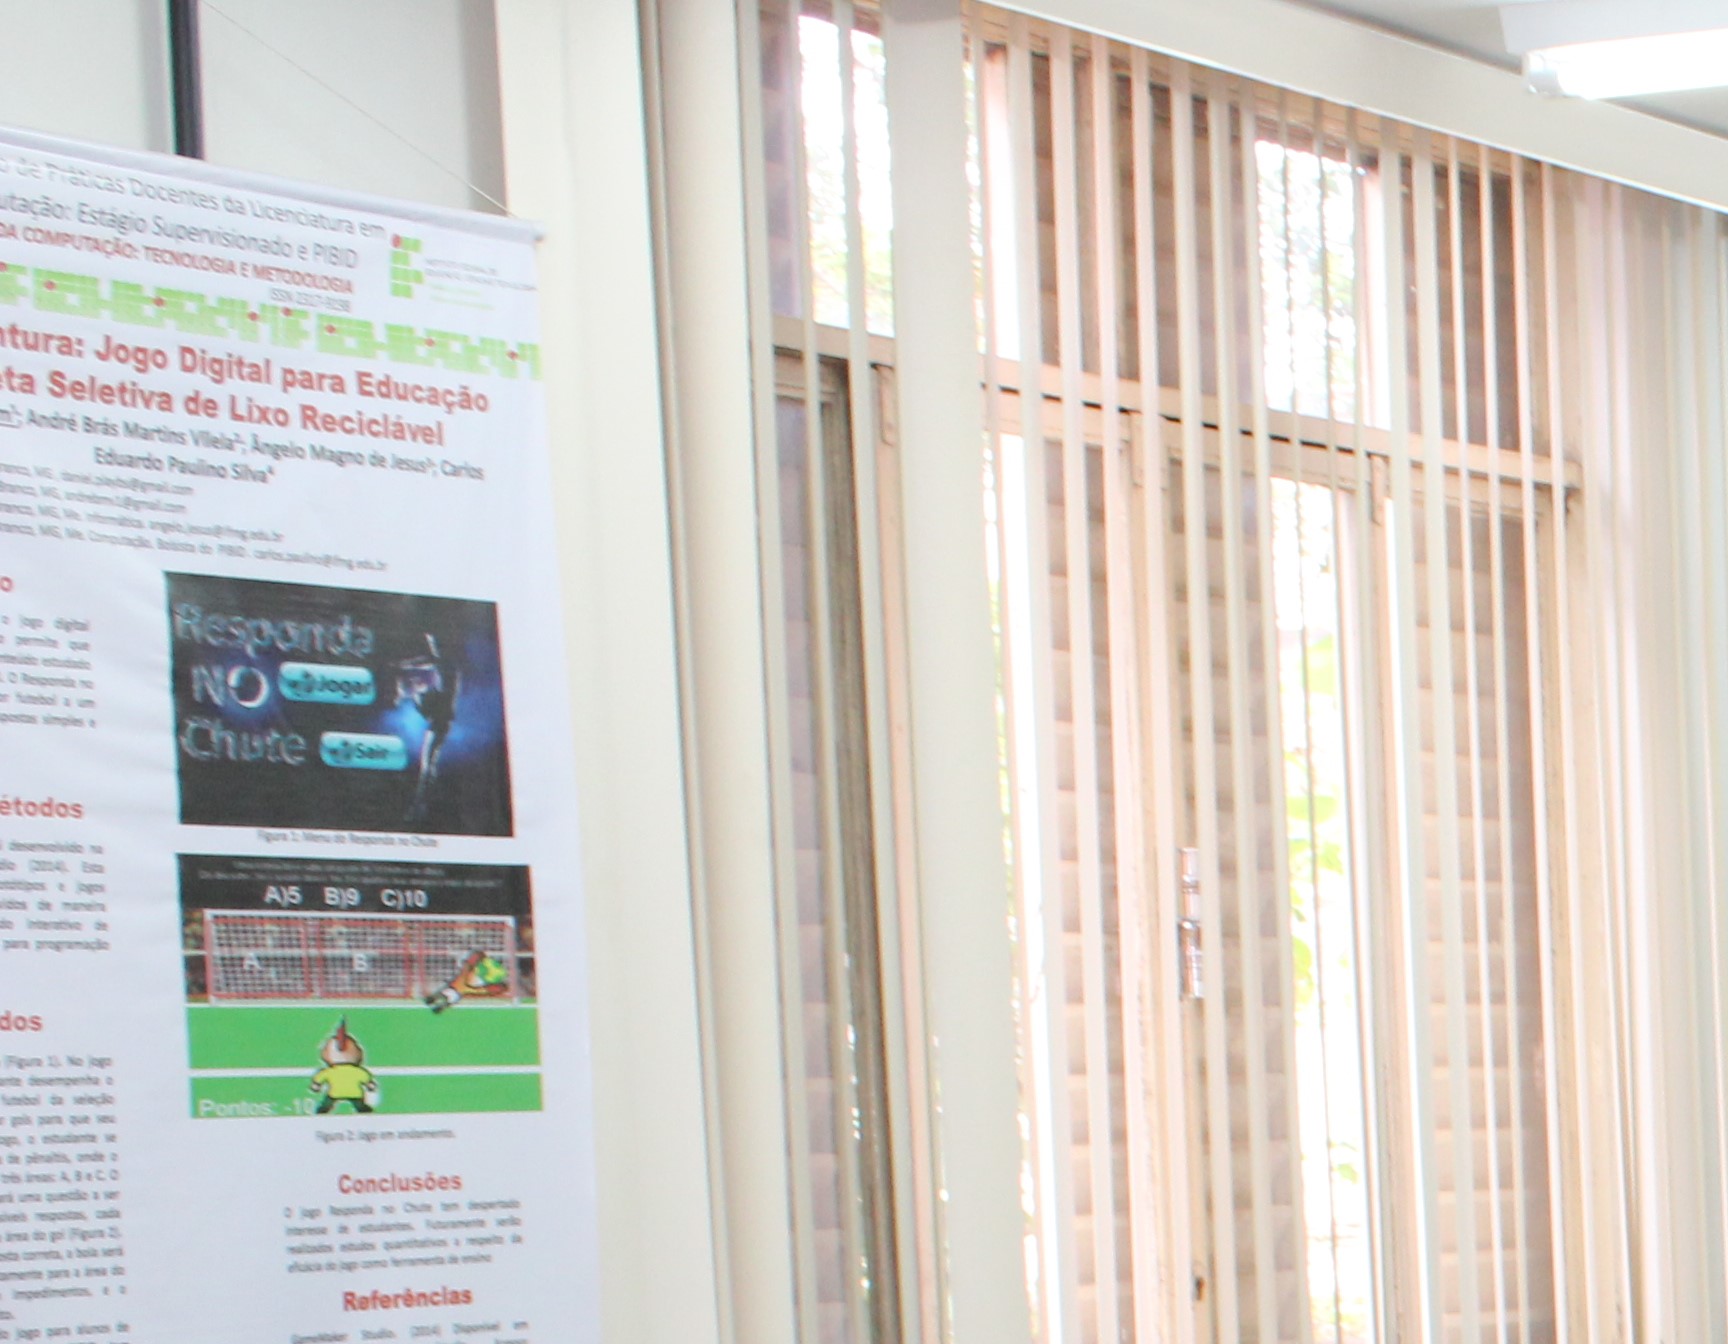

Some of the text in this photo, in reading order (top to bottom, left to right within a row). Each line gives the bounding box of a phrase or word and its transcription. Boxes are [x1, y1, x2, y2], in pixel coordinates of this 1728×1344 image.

[129, 178, 219, 210] Docentes
[223, 196, 247, 215] da
[251, 201, 353, 234] Licenciatura
[360, 222, 386, 239] em
[23, 225, 138, 259] COMPUTAÇÃO:
[143, 245, 237, 275] TECNOLOGIA
[240, 261, 250, 278] E
[254, 264, 354, 294] METODOLOGIA
[77, 202, 147, 235] Estágio
[152, 215, 292, 259] Supervisionado
[297, 244, 308, 258] e
[313, 242, 359, 269] PIBID
[95, 334, 169, 374] Jogo
[179, 345, 272, 385] Digital
[282, 366, 346, 394] para
[356, 371, 490, 415] Educação
[48, 369, 175, 414] Seletiva
[184, 389, 219, 418] de
[230, 394, 291, 428] Lixo
[299, 403, 446, 447] Reciclável
[27, 408, 78, 433] André
[83, 415, 119, 437] Brás
[122, 420, 187, 446] Martins
[251, 432, 306, 461] Ângelo
[309, 443, 365, 468] Magno
[368, 450, 386, 468] de
[440, 459, 485, 481] Carlos
[94, 446, 164, 472] Eduardo
[168, 455, 228, 480] Paulino
[172, 601, 375, 660] Responda
[191, 664, 372, 709] NO Jogar
[181, 716, 307, 766] Chute
[264, 885, 430, 909] A)5 B)9 C)10
[243, 953, 369, 972] A B
[199, 1098, 274, 1119] Pontos:
[337, 1172, 463, 1196] Conclusões
[341, 1286, 475, 1313] Referências
